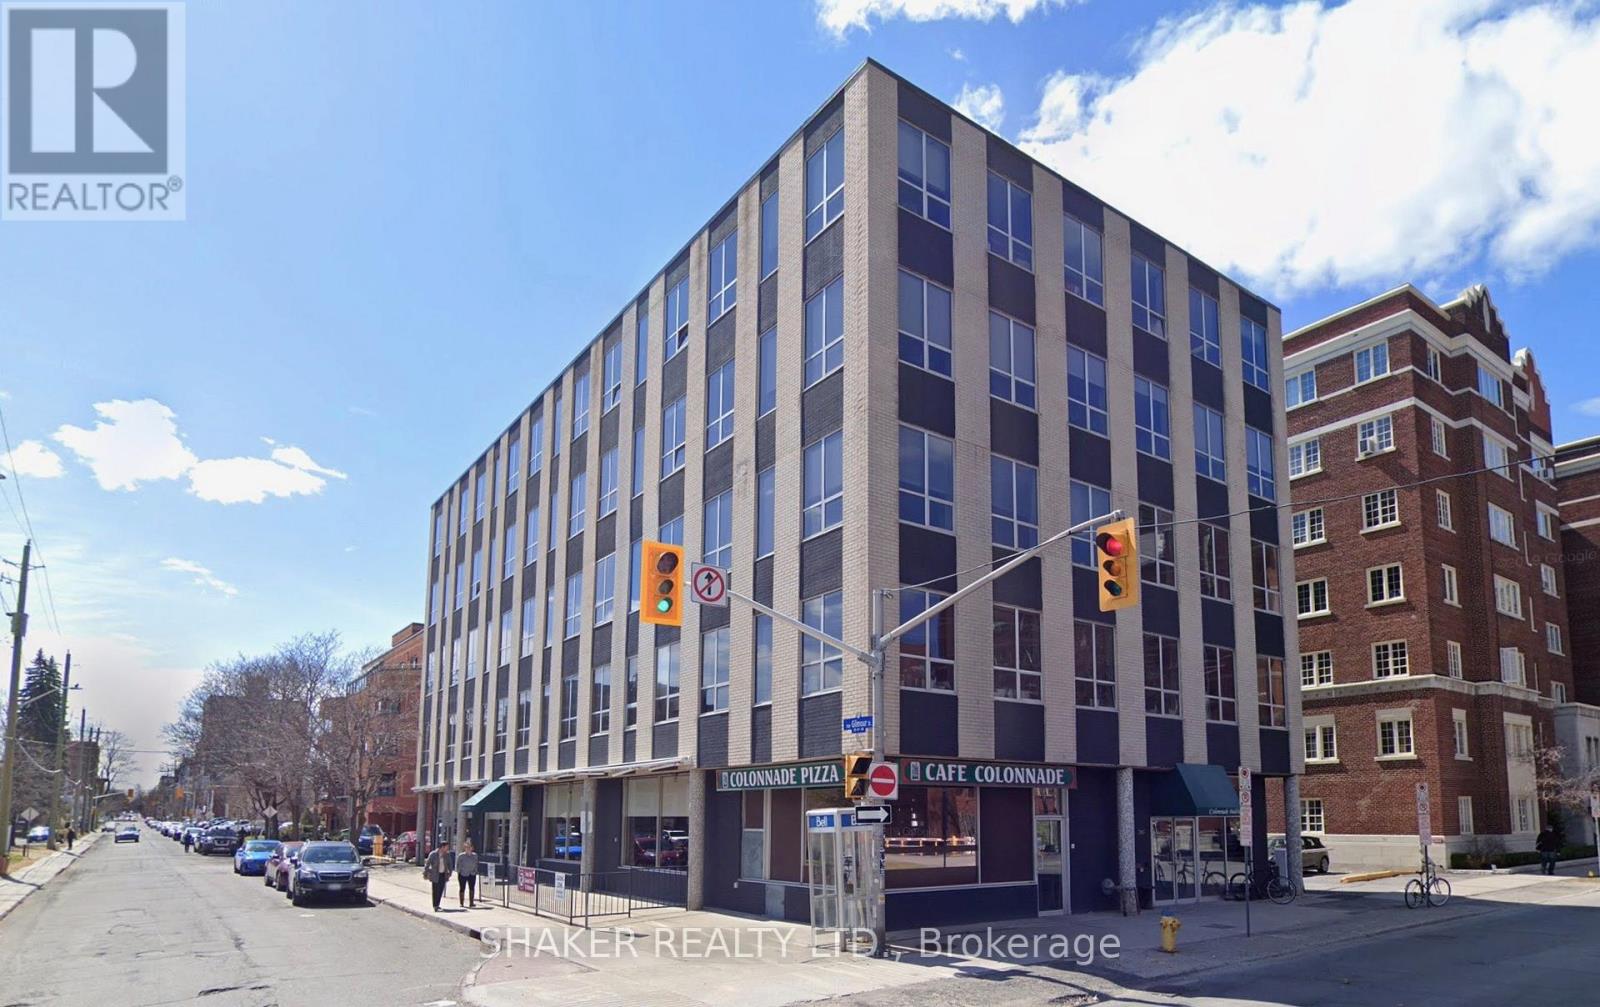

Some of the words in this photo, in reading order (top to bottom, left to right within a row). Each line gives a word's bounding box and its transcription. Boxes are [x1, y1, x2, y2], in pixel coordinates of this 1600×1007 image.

[730, 767, 797, 788] COLONNADE
[801, 764, 840, 784] PIZZA
[925, 763, 967, 783] CAFE
[974, 765, 1065, 785] COLONNADE
[815, 815, 828, 827] Bell
